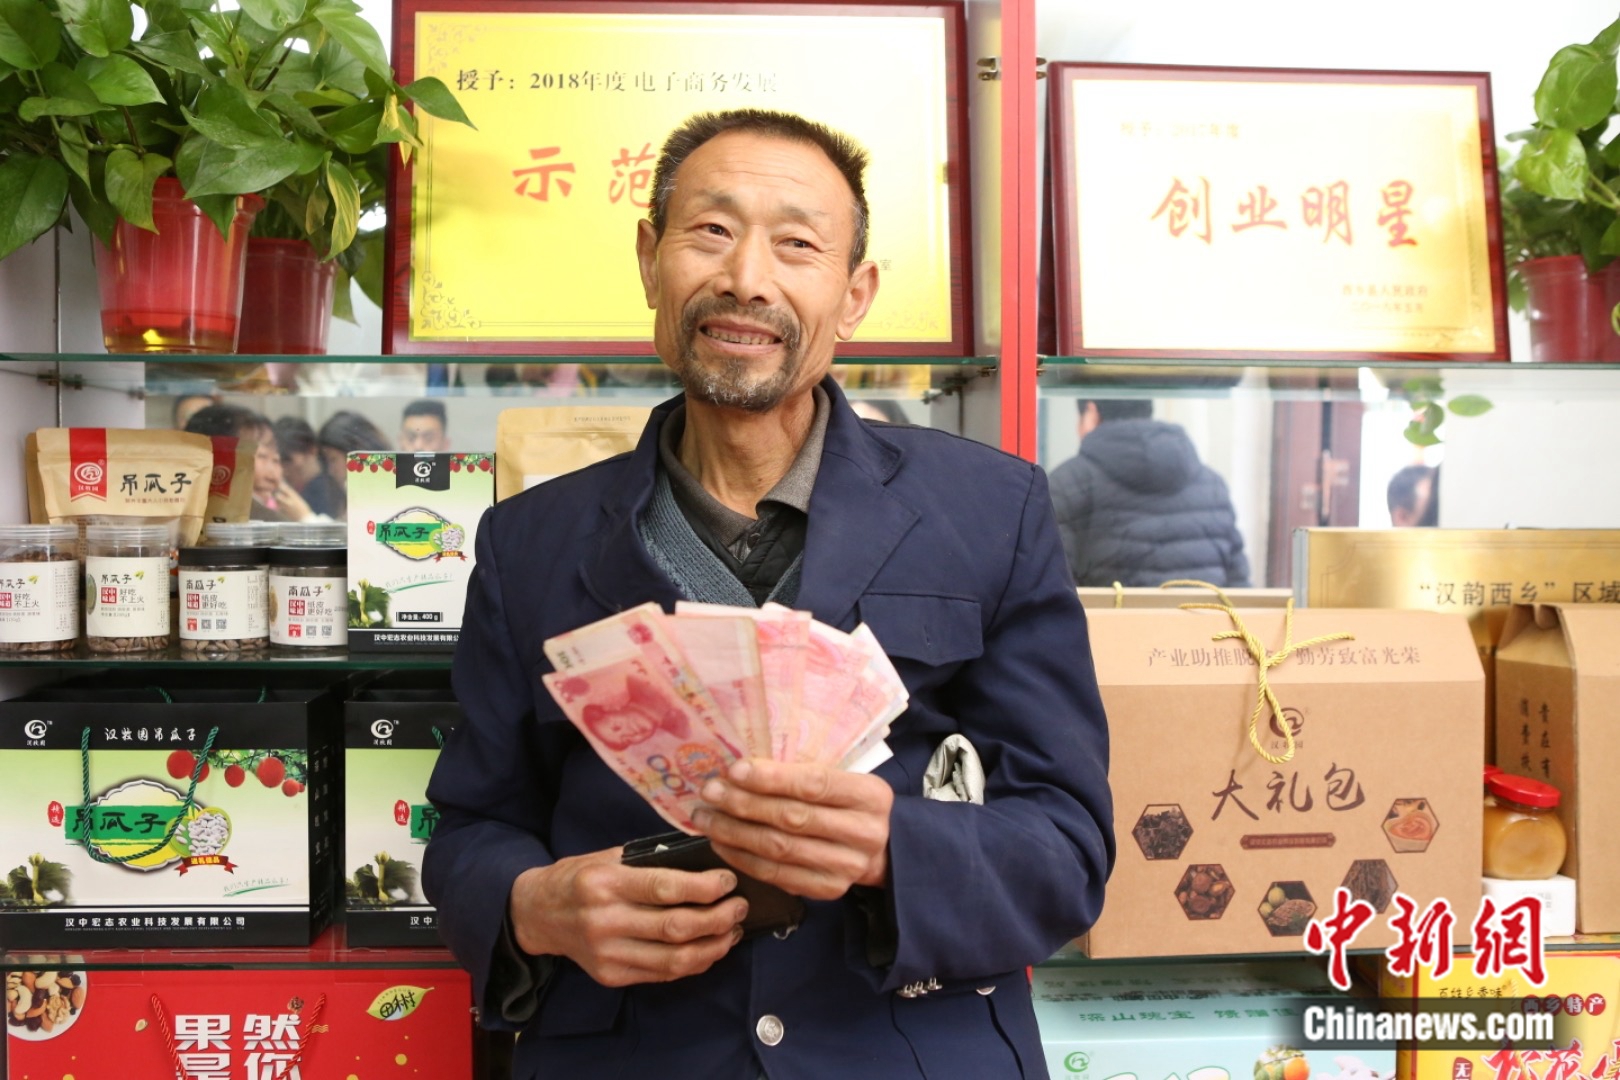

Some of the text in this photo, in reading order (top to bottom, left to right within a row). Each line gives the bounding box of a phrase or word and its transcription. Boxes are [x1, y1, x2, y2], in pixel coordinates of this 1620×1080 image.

[512, 142, 657, 208] 示范
[1151, 176, 1420, 248] 创业明星
[120, 472, 192, 496] 吊瓜子
[380, 524, 430, 541] 吊瓜子
[101, 574, 132, 584] 吊瓜子
[186, 579, 216, 590] 南瓜子
[288, 586, 323, 597] 南瓜子
[1148, 648, 1274, 667] 产业助推脱
[1211, 762, 1366, 821] 大礼包
[72, 807, 167, 834] 吊瓜子
[65, 916, 245, 927] 汉中宏志农业科技发展有限公司
[174, 1013, 302, 1051] 果然
